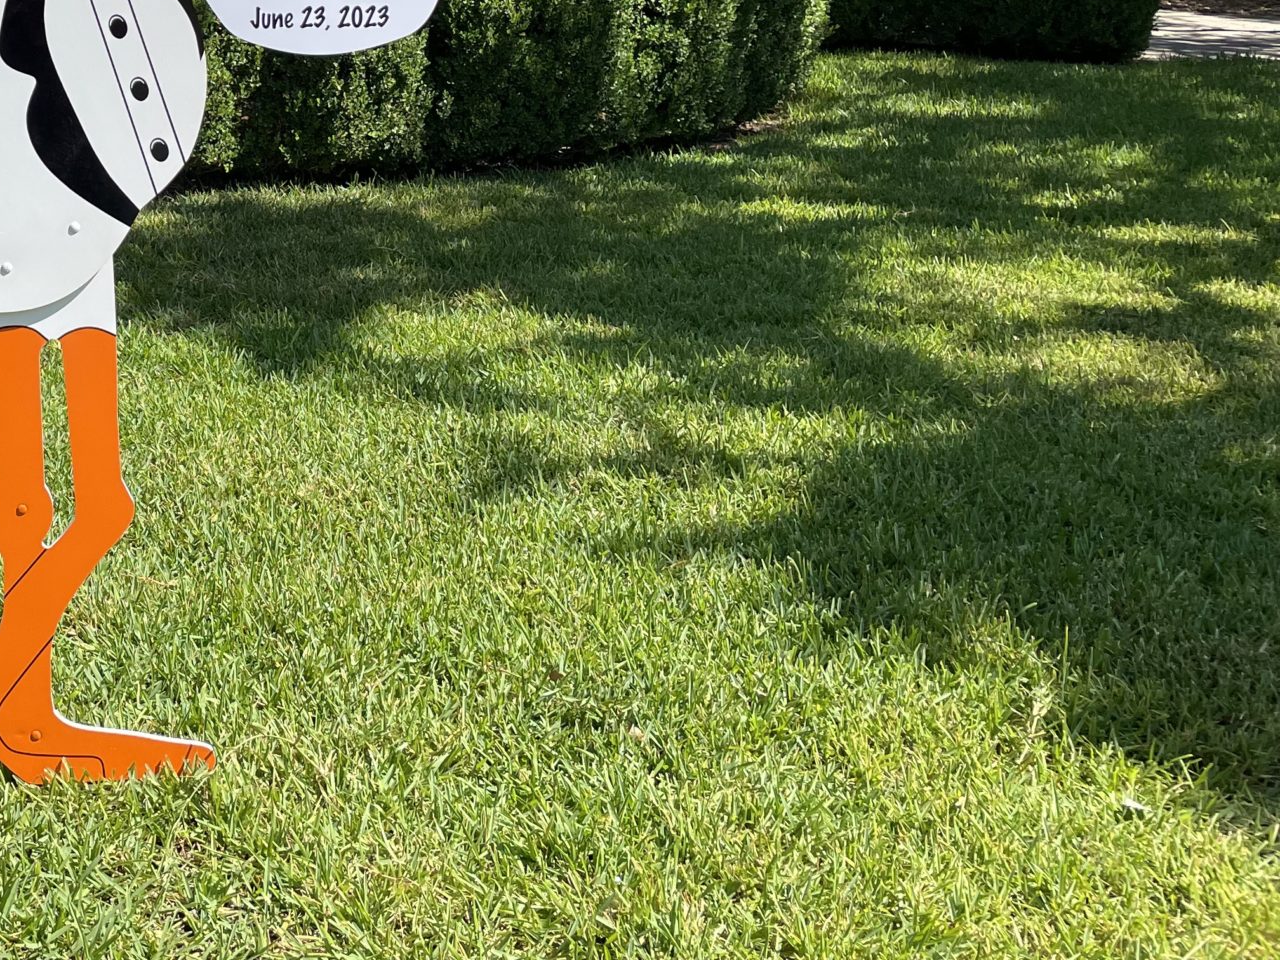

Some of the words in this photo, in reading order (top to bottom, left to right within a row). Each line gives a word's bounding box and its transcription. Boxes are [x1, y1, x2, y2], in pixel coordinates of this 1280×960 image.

[250, 6, 294, 29] June
[300, 5, 330, 31] 23,
[337, 5, 390, 29] 2023
